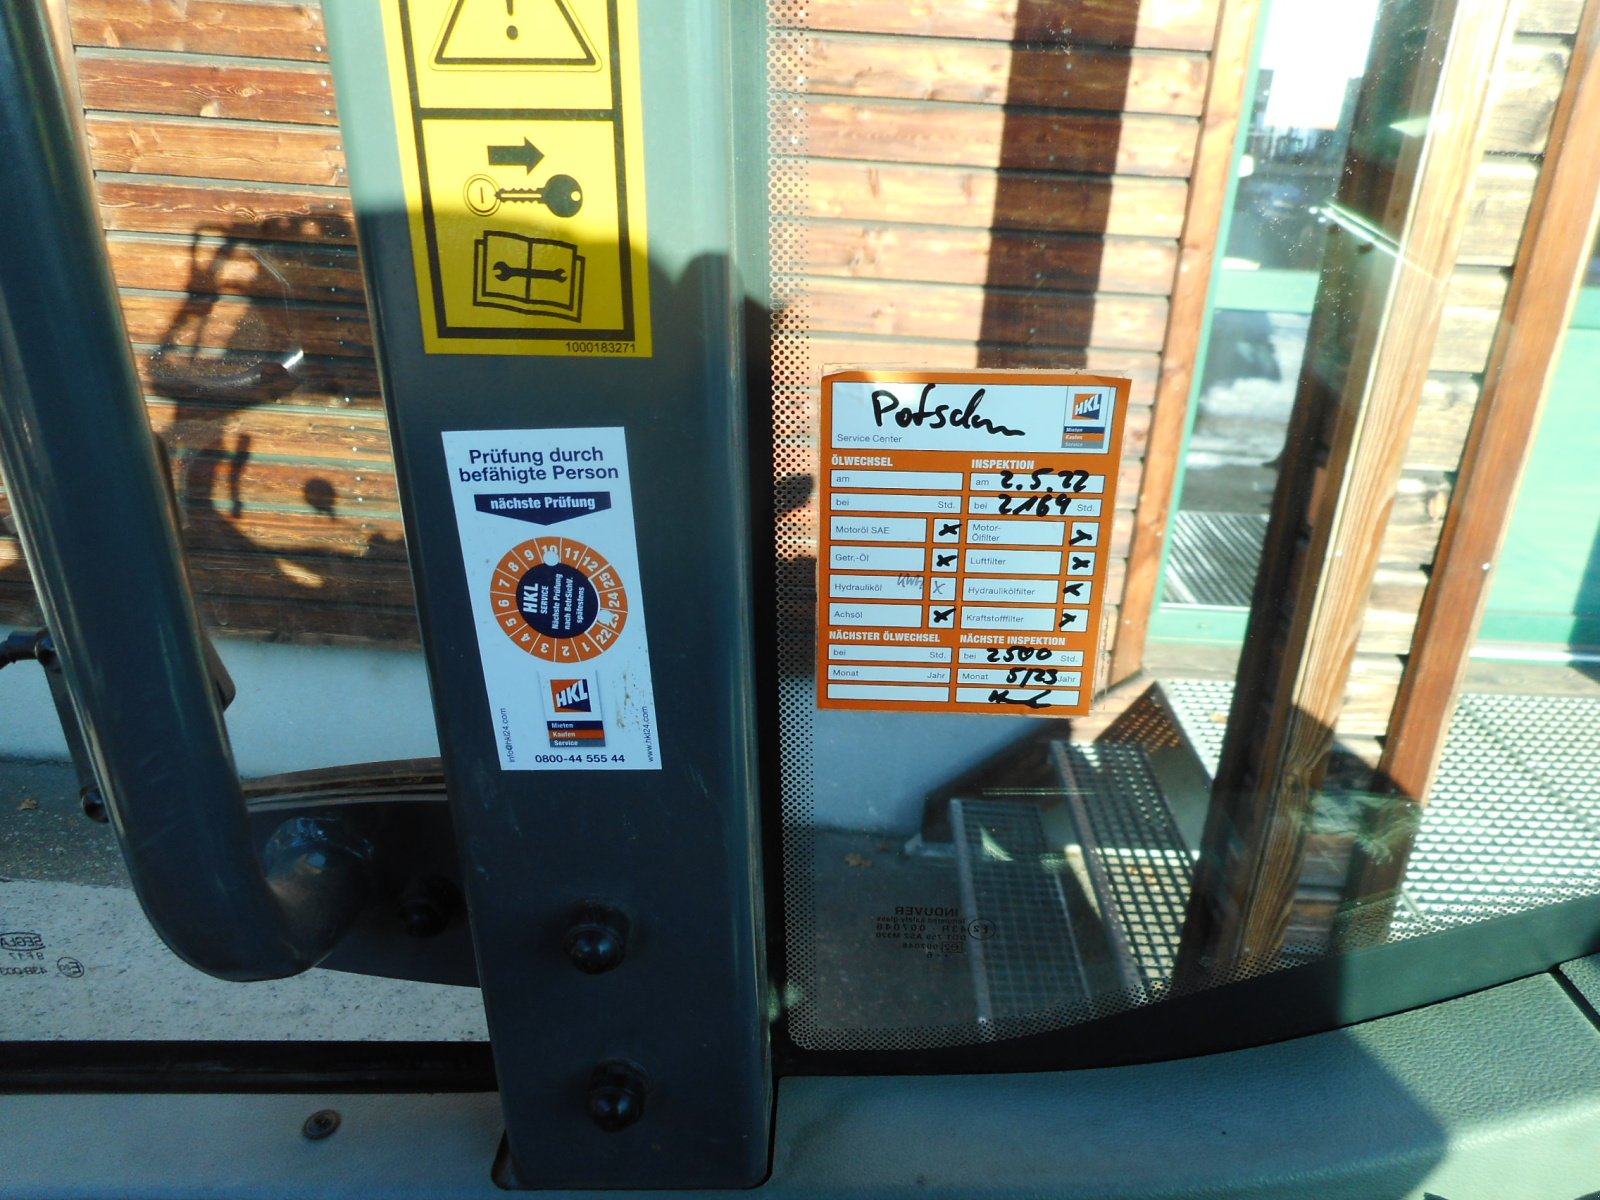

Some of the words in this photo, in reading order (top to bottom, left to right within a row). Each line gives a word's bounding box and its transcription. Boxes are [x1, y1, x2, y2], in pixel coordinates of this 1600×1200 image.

[565, 341, 637, 354] 1000183271
[1074, 394, 1101, 416] HKL
[837, 434, 870, 443] Service
[872, 434, 903, 444] Center
[469, 449, 544, 466] Prüfung
[549, 446, 604, 462] durch
[831, 454, 893, 467] ÖLWECHSEL
[971, 459, 1035, 470] INSPEKTION
[459, 467, 547, 484] befähigte
[552, 465, 619, 480] Person
[490, 497, 541, 510] nächste
[544, 496, 596, 511] Prüfung
[836, 498, 850, 506] bei
[937, 501, 955, 509] Std.
[974, 502, 988, 510] bei
[1077, 503, 1095, 512] Std.
[835, 525, 869, 534] Motoröl
[972, 524, 1001, 532] Motor-
[971, 533, 1001, 542] Ölfilter
[523, 549, 535, 561] 9
[565, 547, 580, 561] 11
[583, 556, 599, 572] 12
[970, 557, 1006, 565] Luftfilter
[508, 561, 520, 573] 8
[498, 579, 510, 588] 7
[599, 572, 615, 589] 25
[553, 573, 563, 601] Prüfung
[834, 583, 882, 592] Hydrauliköl
[968, 586, 1036, 595] Hydraulikölfilter
[523, 582, 539, 614] HKL
[540, 585, 549, 615] SERVICE
[607, 591, 620, 608] 24
[577, 586, 585, 623] spätestens
[552, 602, 560, 630] Nächste
[833, 610, 863, 618] Achsöl
[505, 618, 517, 627] 5
[520, 633, 531, 642] 4
[596, 629, 612, 645] 22
[829, 629, 880, 641] NÄCHSTER
[883, 631, 940, 642] ÖLWECHSEL
[960, 633, 1005, 644] NÄCHSTE
[1007, 635, 1066, 646] INSPEKTION
[540, 643, 549, 653] 3
[561, 646, 570, 656] 2
[581, 642, 591, 652] 1
[833, 648, 846, 656] bei
[929, 651, 946, 659] Std.
[963, 652, 977, 660] bei
[986, 646, 1052, 662] 2500
[1060, 655, 1078, 663] Std.
[833, 669, 859, 677] Monat
[1057, 675, 1076, 683] Jahr
[555, 679, 589, 708] HKL
[641, 705, 653, 762] www.hkl24.com
[535, 754, 583, 763] 0800-44
[586, 754, 608, 763] 555
[611, 754, 626, 763] 44
